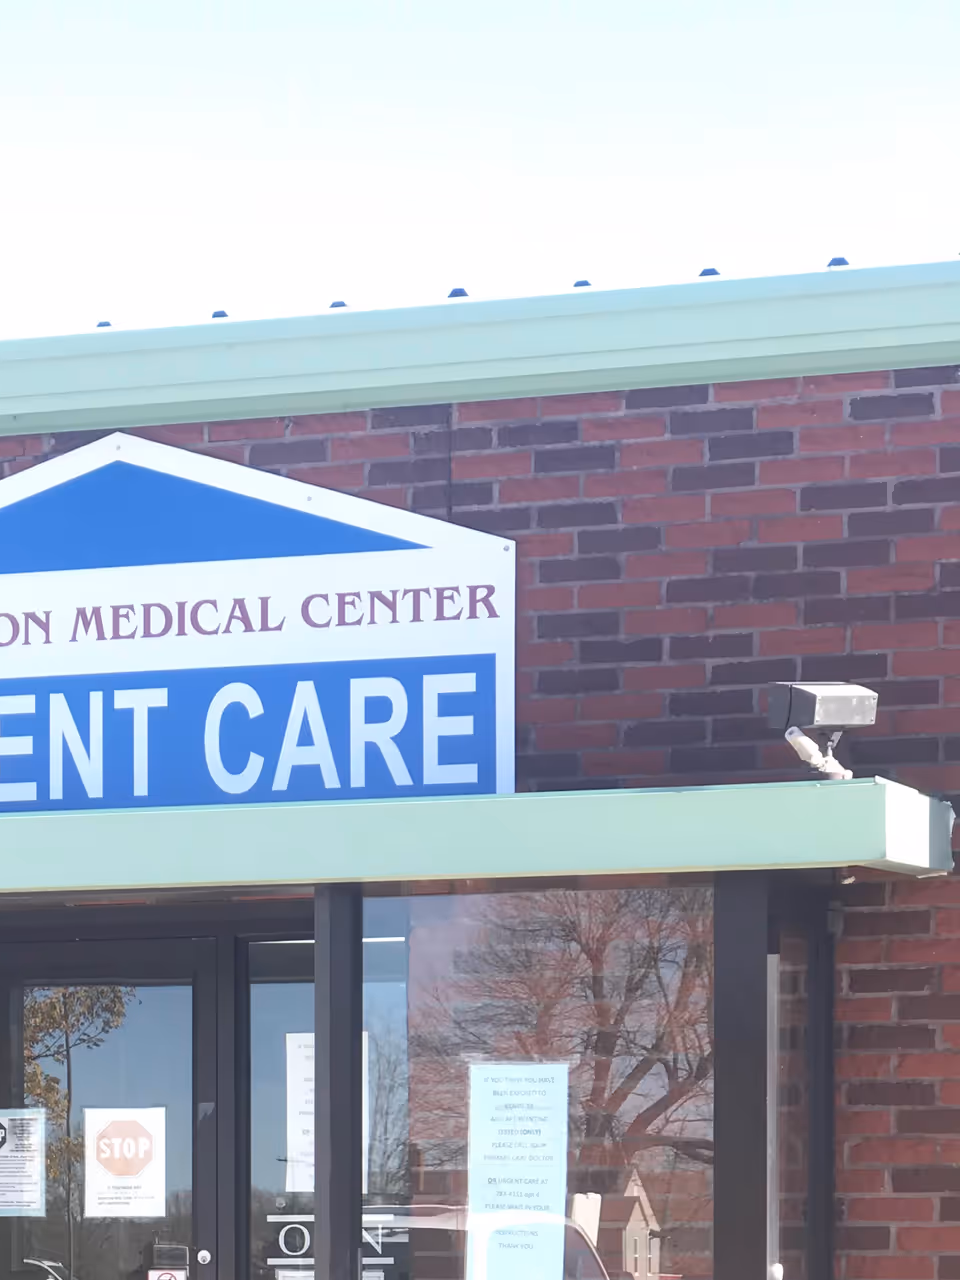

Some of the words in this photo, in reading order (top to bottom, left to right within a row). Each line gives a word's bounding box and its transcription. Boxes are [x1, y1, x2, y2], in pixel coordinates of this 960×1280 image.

[69, 595, 287, 642] MEDICAL
[301, 583, 501, 629] CENTER
[204, 672, 480, 794] CARE
[98, 1138, 153, 1160] STOP
